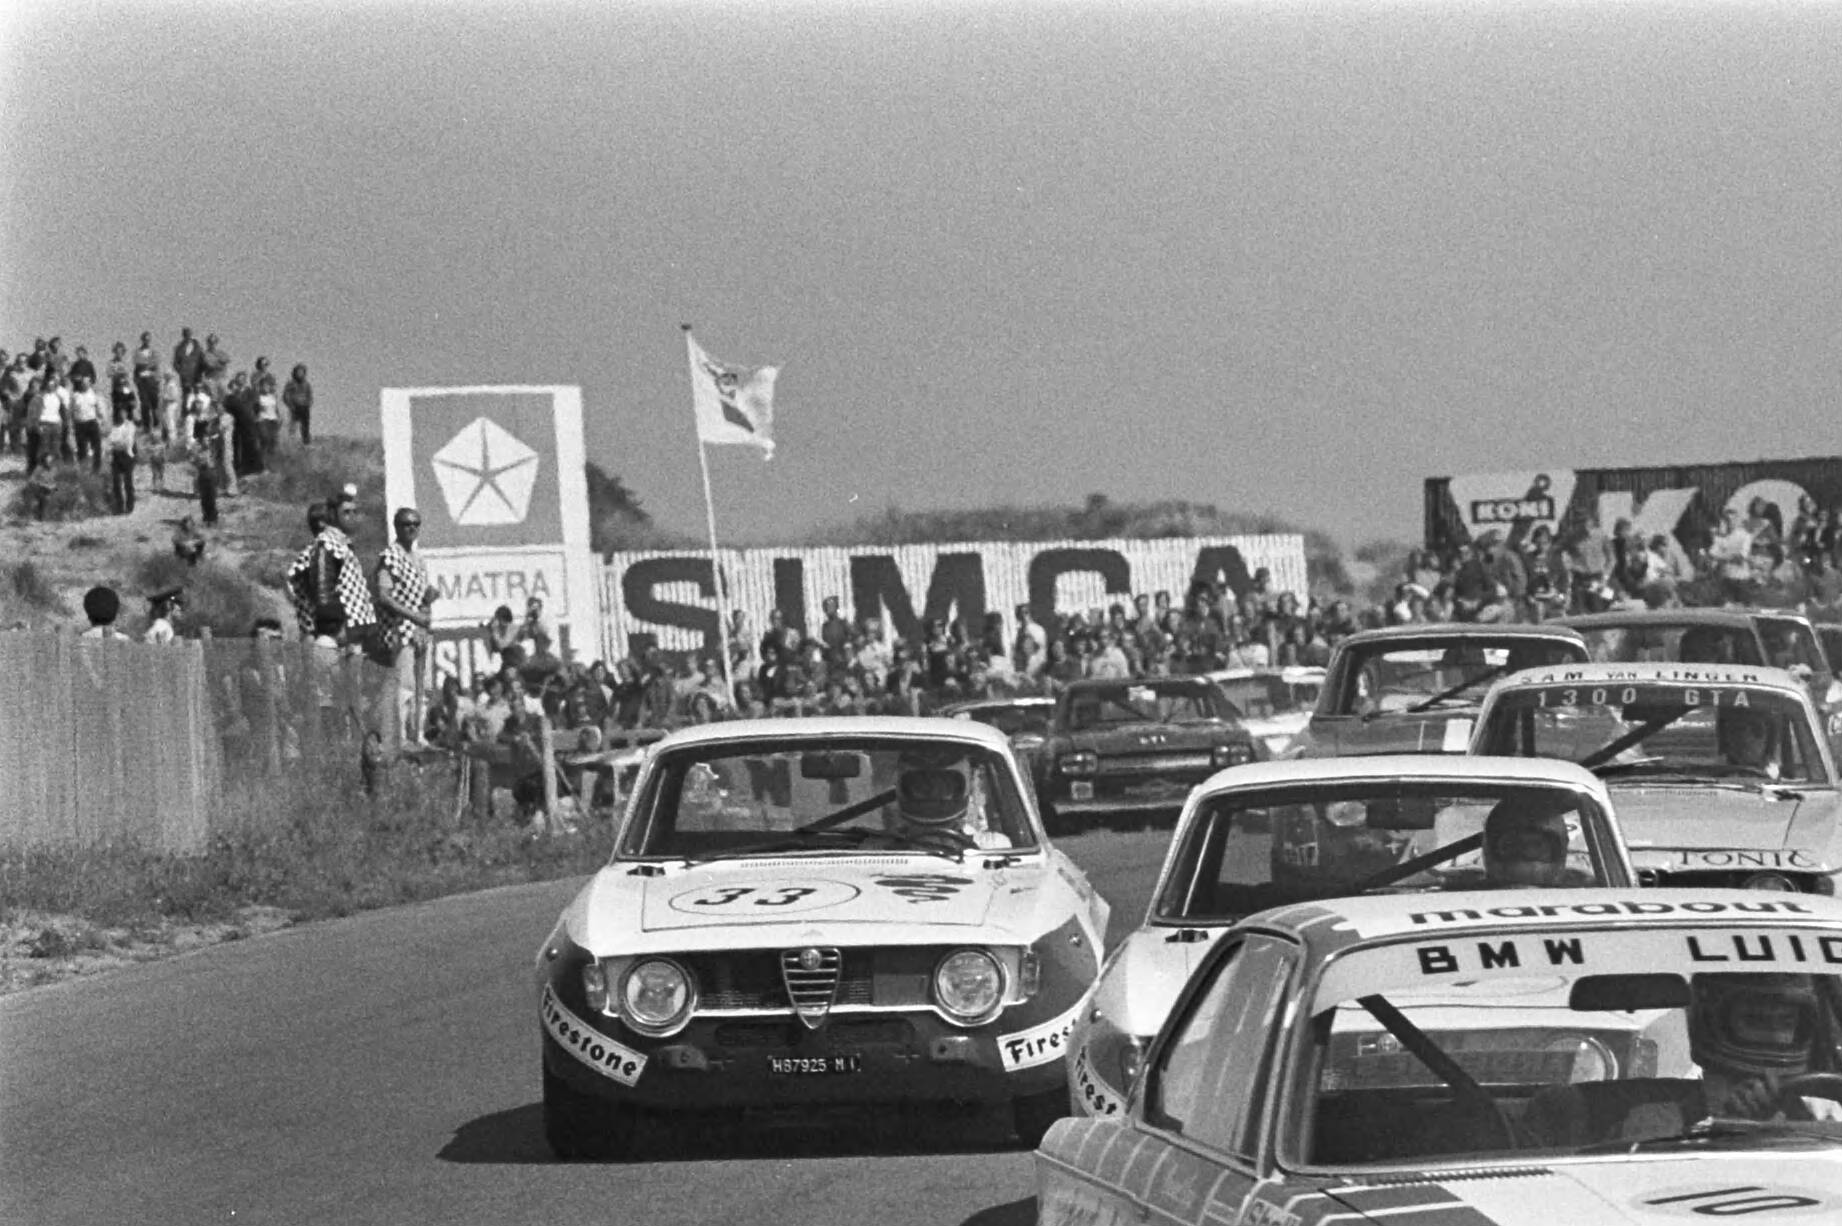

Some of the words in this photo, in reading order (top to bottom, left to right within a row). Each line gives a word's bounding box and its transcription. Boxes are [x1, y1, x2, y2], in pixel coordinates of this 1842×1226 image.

[1477, 500, 1551, 521] KONI
[435, 569, 552, 600] MATRA
[1536, 686, 1638, 707] 1300
[1684, 688, 1750, 708] GTA
[694, 887, 817, 906] 33
[1410, 900, 1813, 925] marabout
[1416, 937, 1586, 976] BMW
[543, 986, 637, 1077] Firestone
